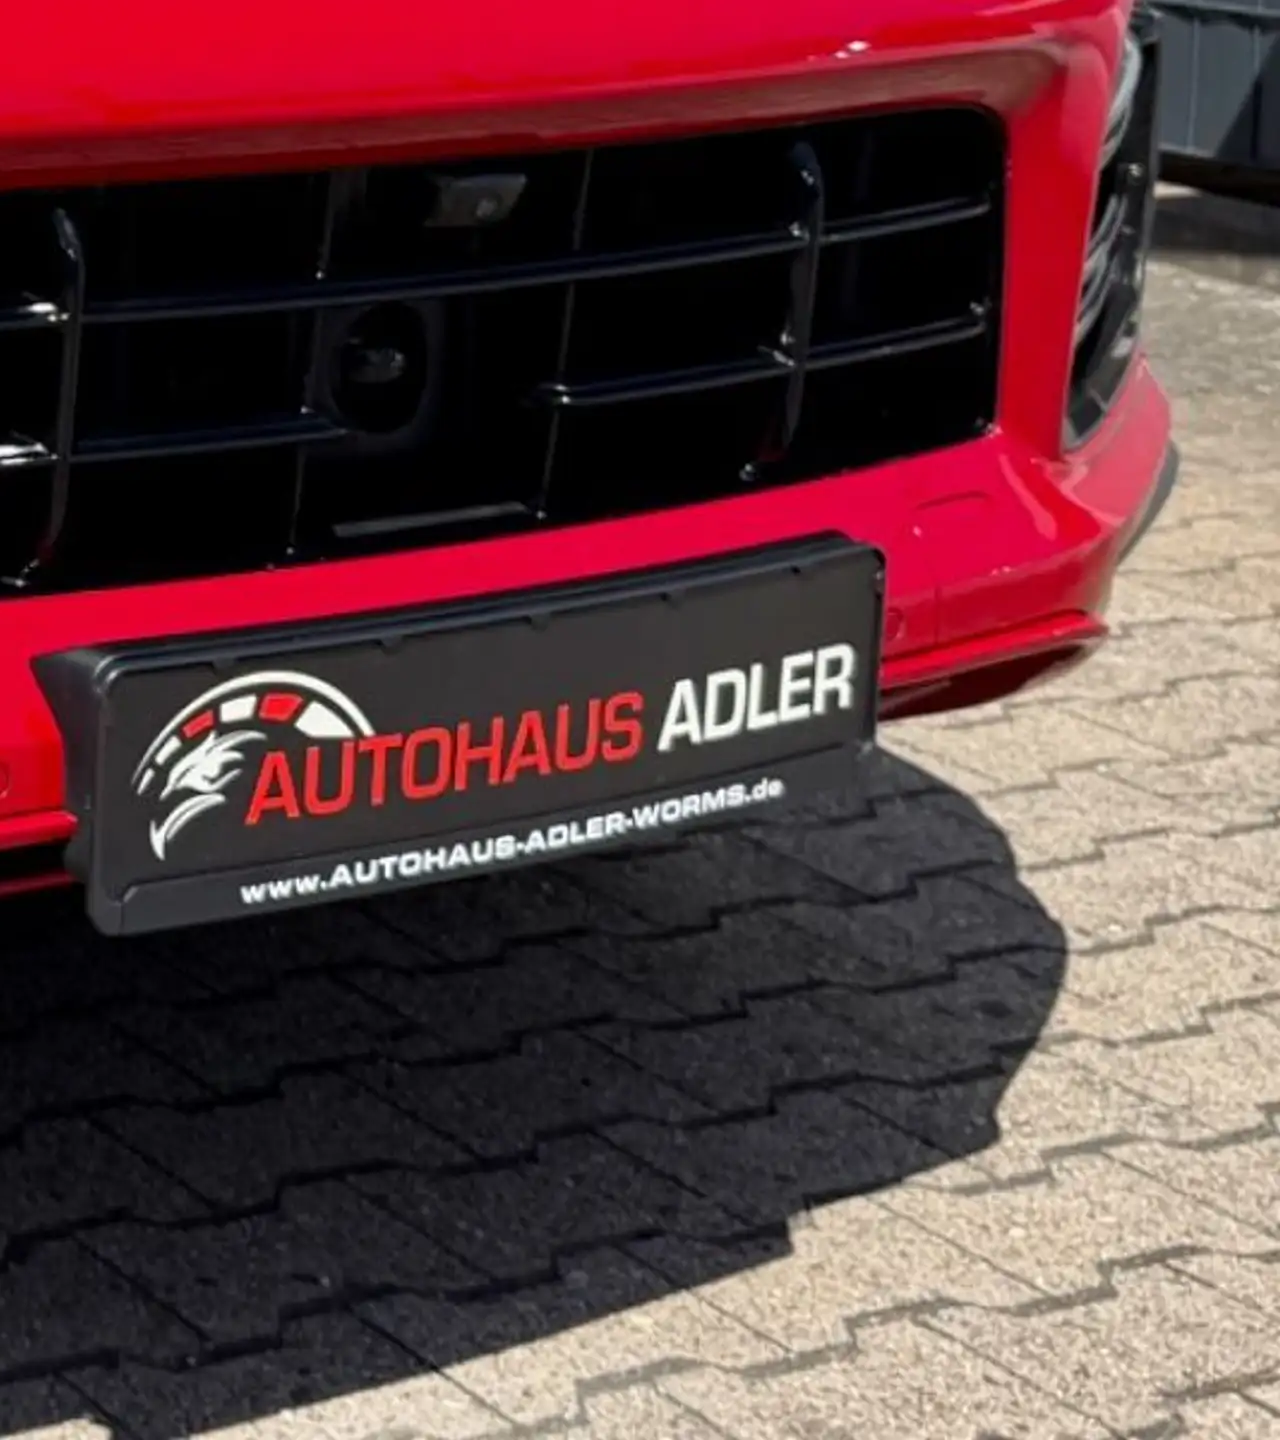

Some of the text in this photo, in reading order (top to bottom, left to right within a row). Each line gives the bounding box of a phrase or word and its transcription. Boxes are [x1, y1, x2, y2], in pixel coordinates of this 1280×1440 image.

[246, 644, 857, 824] AUTOHAUS ADLER
[241, 778, 783, 903] www.AUTOHAUS-ADLER-WORMS.de
